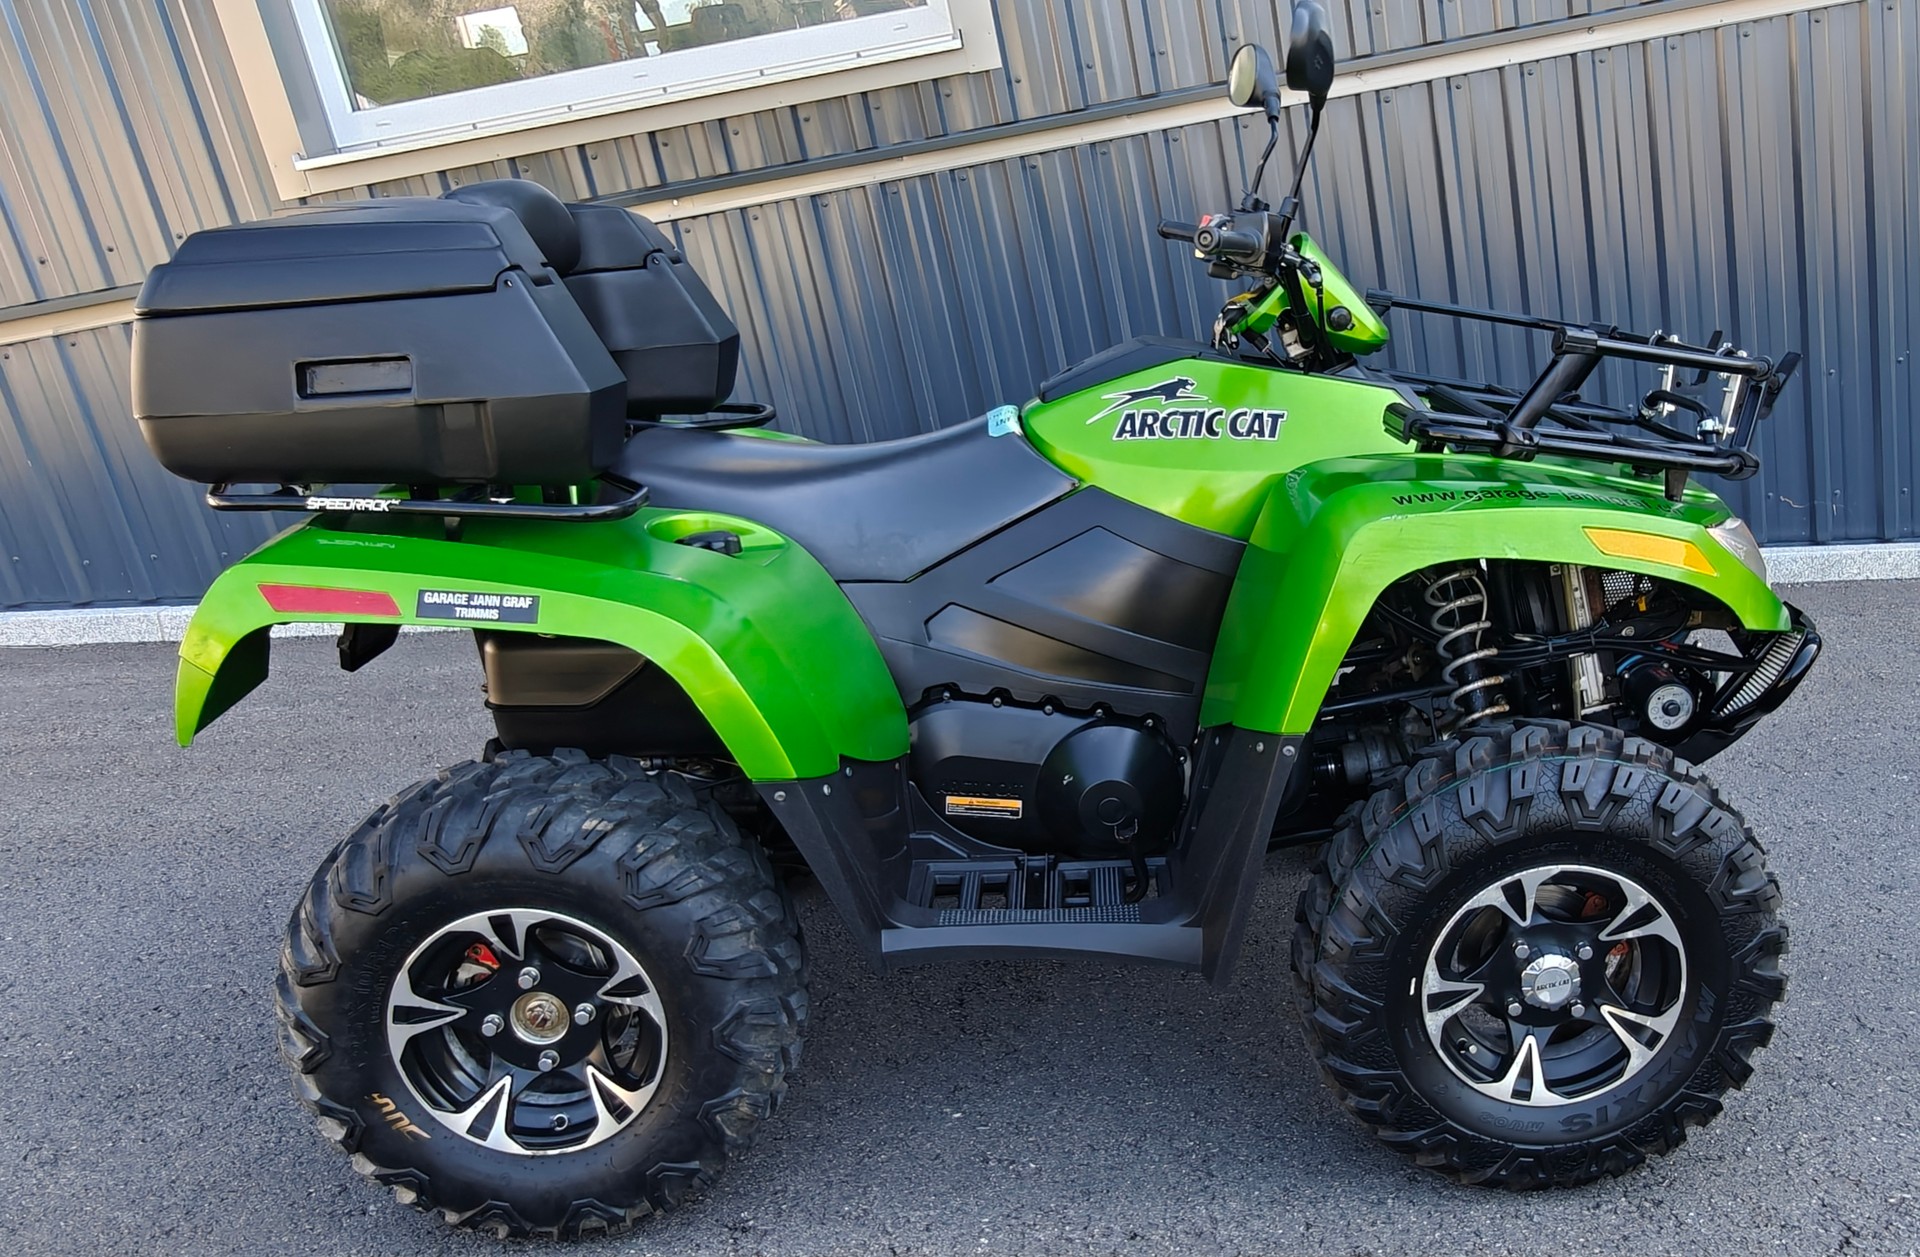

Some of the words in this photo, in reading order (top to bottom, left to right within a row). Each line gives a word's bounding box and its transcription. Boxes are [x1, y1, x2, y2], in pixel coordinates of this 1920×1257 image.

[1112, 407, 1225, 441] ARCTIC
[1226, 408, 1288, 441] CAT
[306, 497, 389, 511] SPEEDRACK
[424, 592, 469, 605] GARAGE
[470, 594, 500, 607] JANN
[502, 596, 533, 609] GRAF
[455, 606, 499, 619] TRIMMIS
[1560, 981, 1718, 1133] MAXXIS
